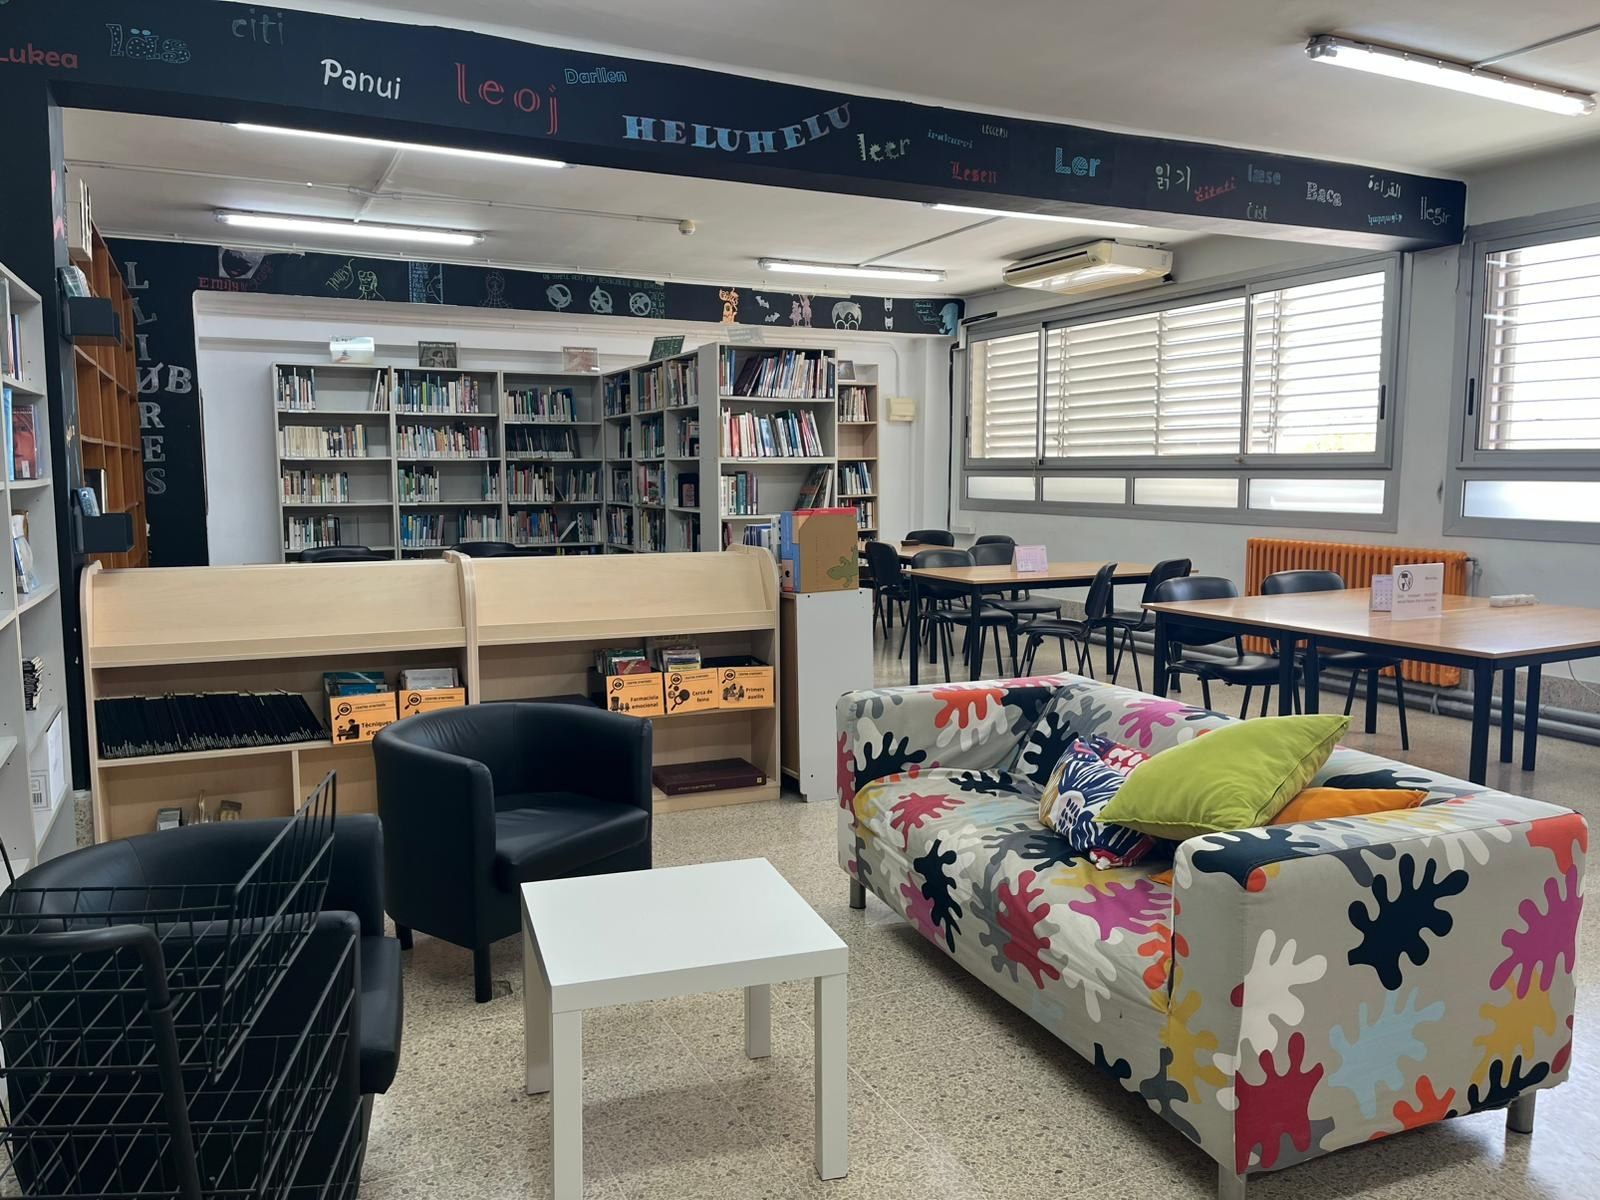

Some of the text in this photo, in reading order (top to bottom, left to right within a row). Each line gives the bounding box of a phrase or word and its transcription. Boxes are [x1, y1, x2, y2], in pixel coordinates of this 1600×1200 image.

[320, 58, 402, 100] Panui
[564, 67, 628, 85] Darllen
[454, 62, 559, 136] leoj
[622, 102, 851, 154] HELUHELU
[856, 132, 911, 163] leer
[1054, 147, 1101, 177] Ler
[950, 161, 998, 184] Lesen
[1306, 181, 1343, 207] Baca
[1420, 196, 1451, 226] llegir
